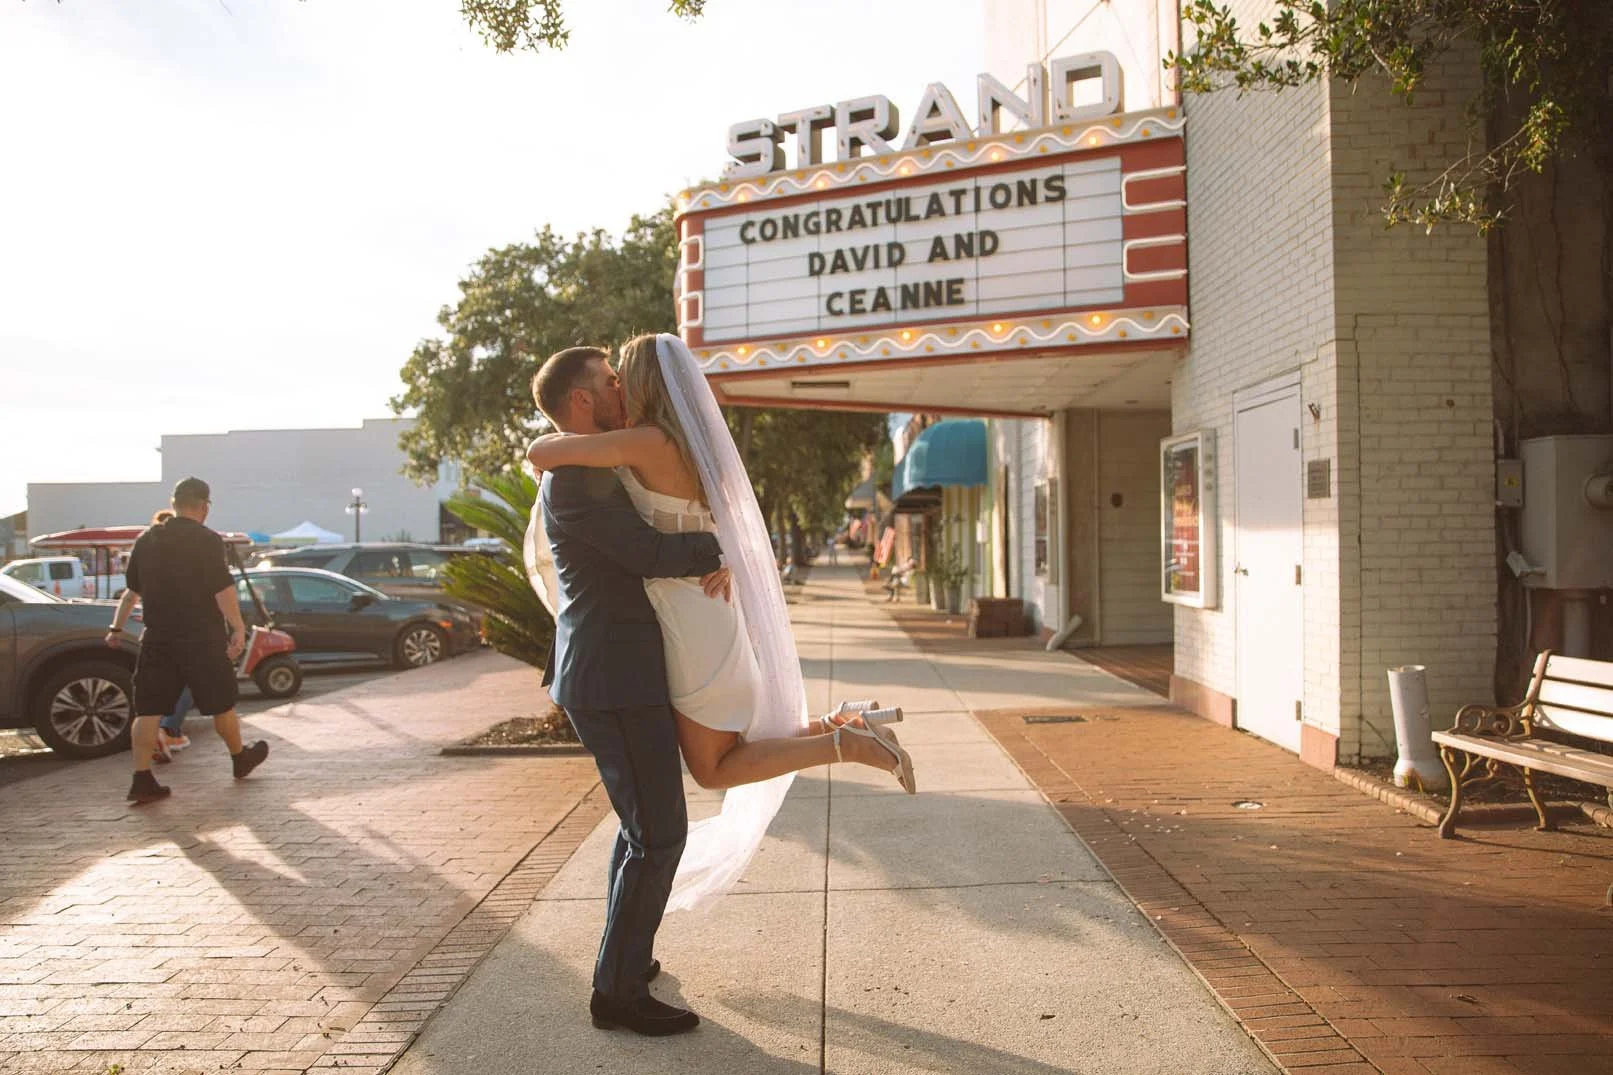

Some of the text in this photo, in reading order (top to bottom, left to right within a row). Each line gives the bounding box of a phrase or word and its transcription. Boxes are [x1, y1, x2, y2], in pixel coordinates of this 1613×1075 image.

[724, 50, 1124, 175] STRAND
[739, 175, 1067, 245] CONGRATULATIONS
[808, 229, 999, 277] DAVID AND
[826, 278, 965, 317] CEANNE
